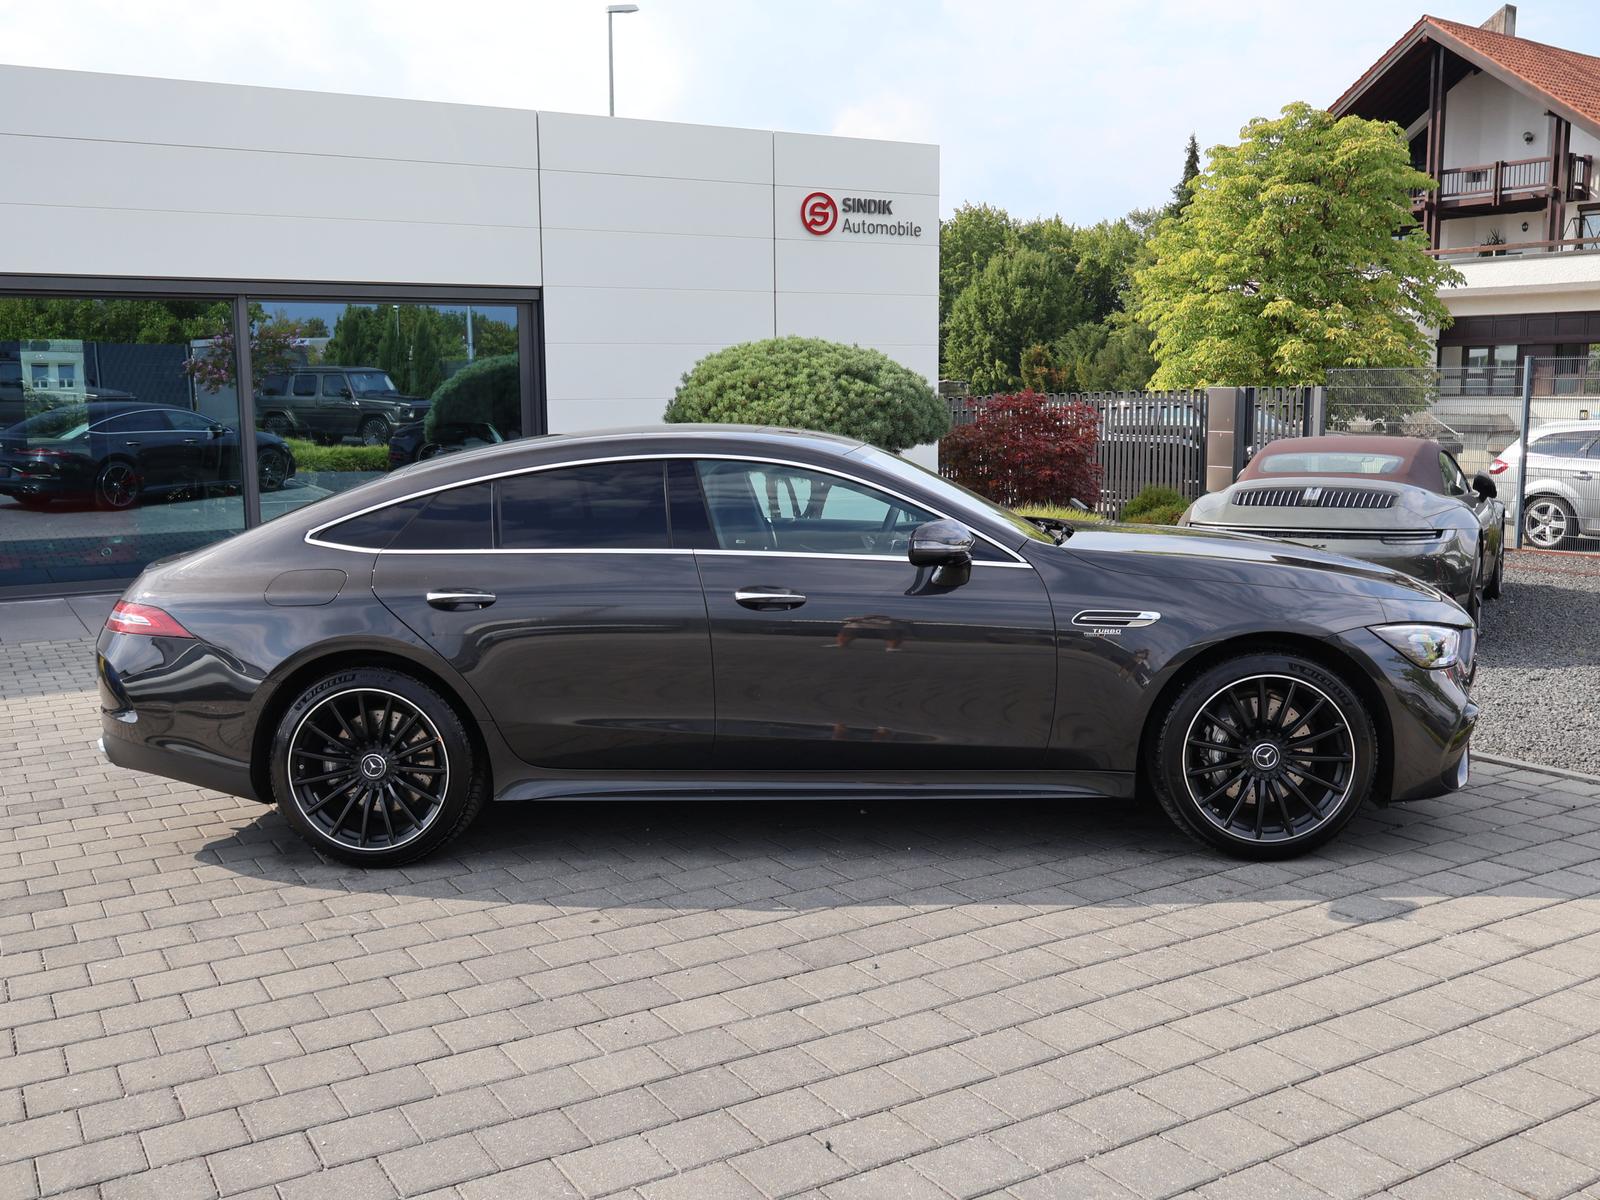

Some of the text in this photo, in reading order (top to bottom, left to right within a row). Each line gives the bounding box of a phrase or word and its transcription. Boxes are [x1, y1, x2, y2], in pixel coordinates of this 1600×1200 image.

[842, 197, 893, 215] SINDIK
[842, 218, 922, 237] Automobile
[305, 673, 354, 700] MICHELIN
